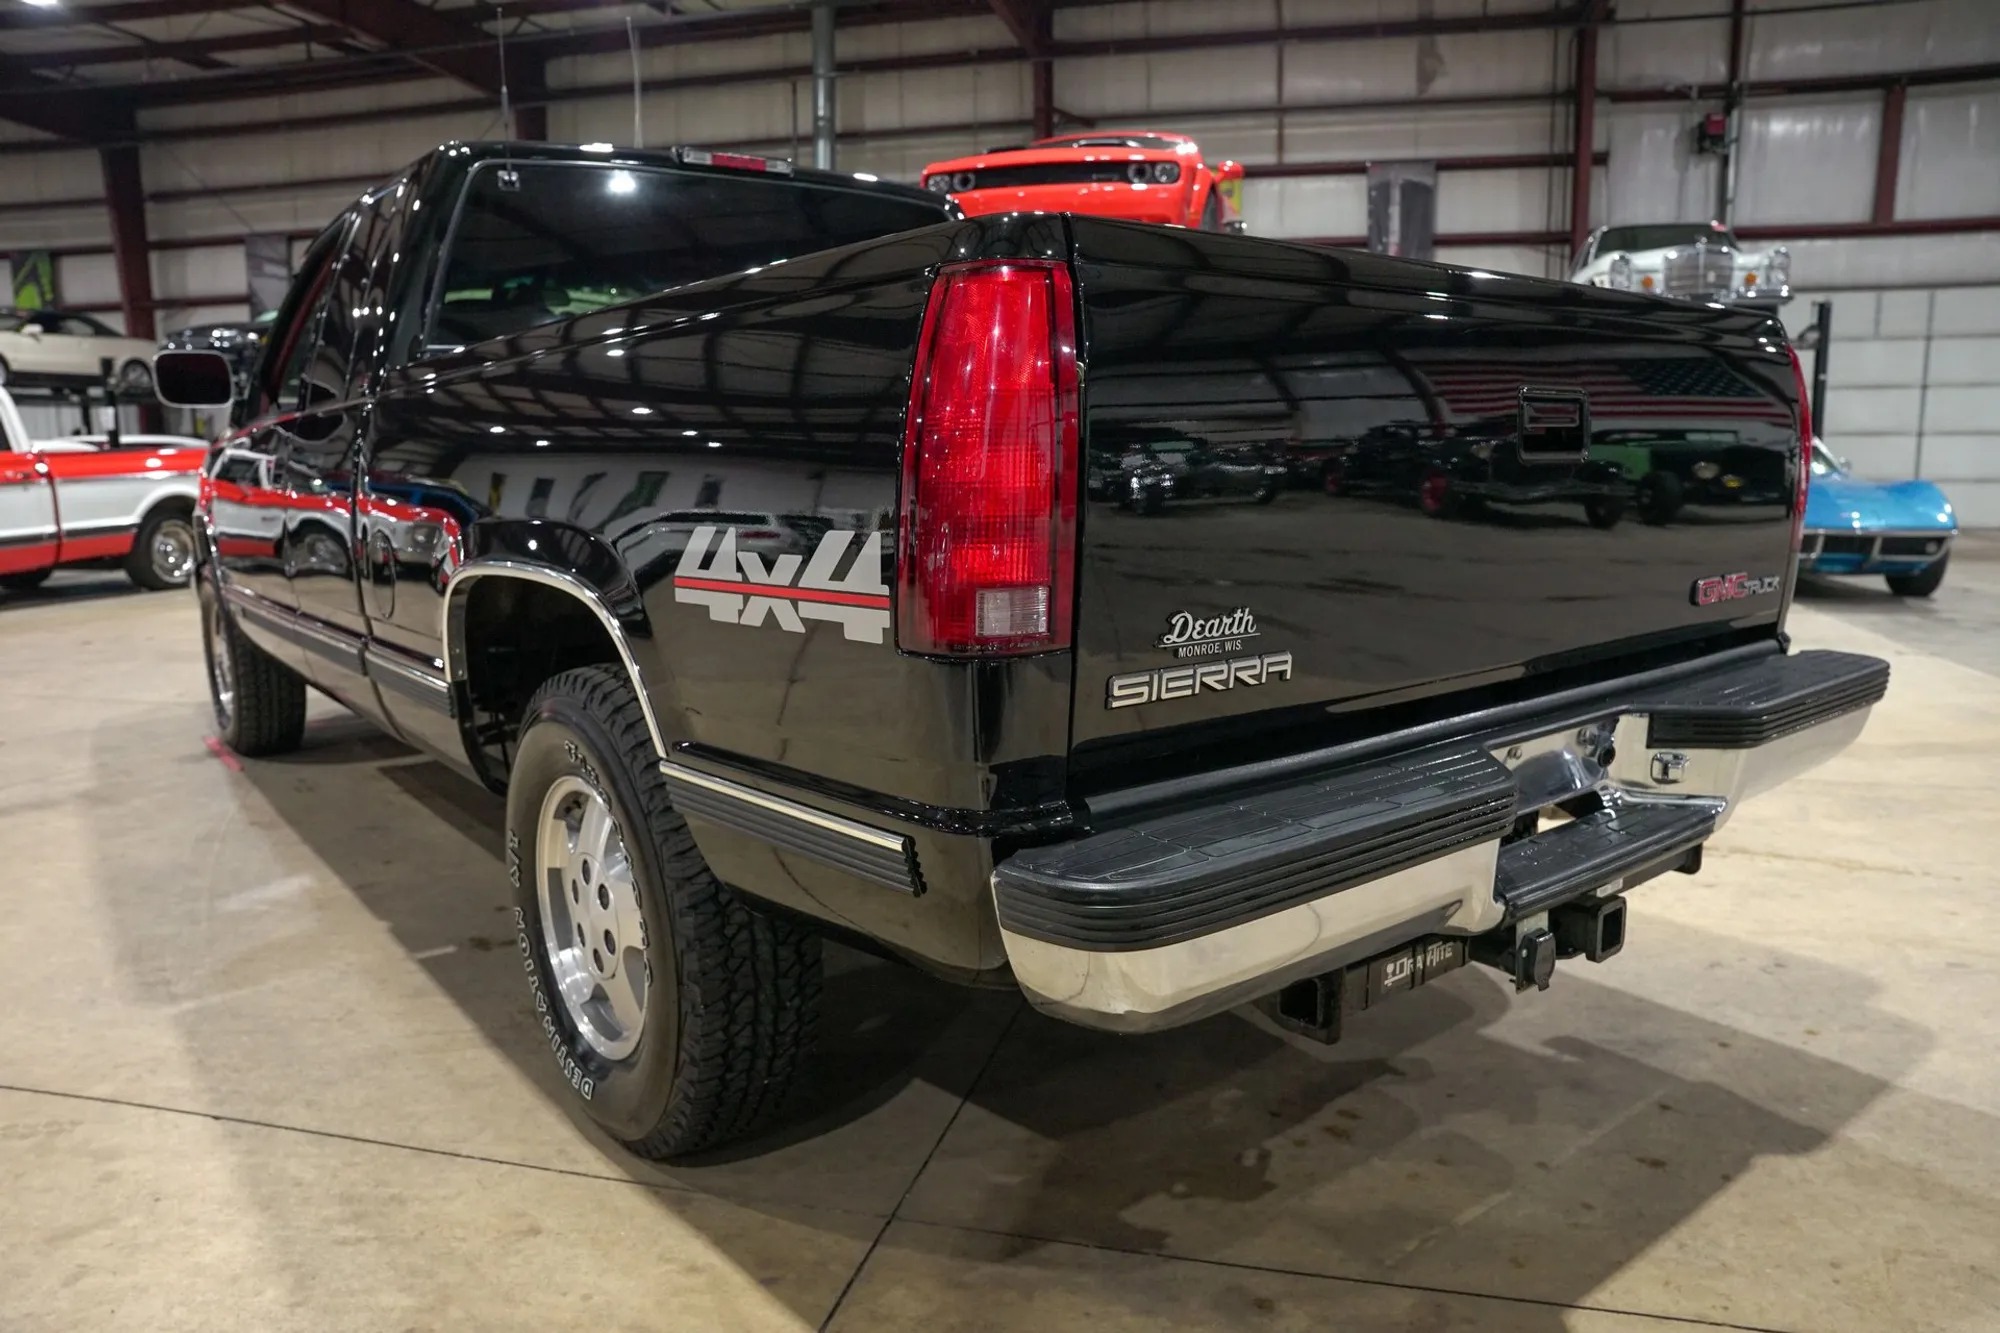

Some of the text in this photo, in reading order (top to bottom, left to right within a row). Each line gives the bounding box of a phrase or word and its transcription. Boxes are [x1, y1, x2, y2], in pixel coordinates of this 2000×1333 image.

[1697, 572, 1780, 605] GMC TRUCK
[1162, 607, 1257, 644] Dearth
[1178, 639, 1243, 658] MONROE, WIS.
[1106, 651, 1293, 709] SIERRA
[513, 906, 595, 1101] DESTINATION
